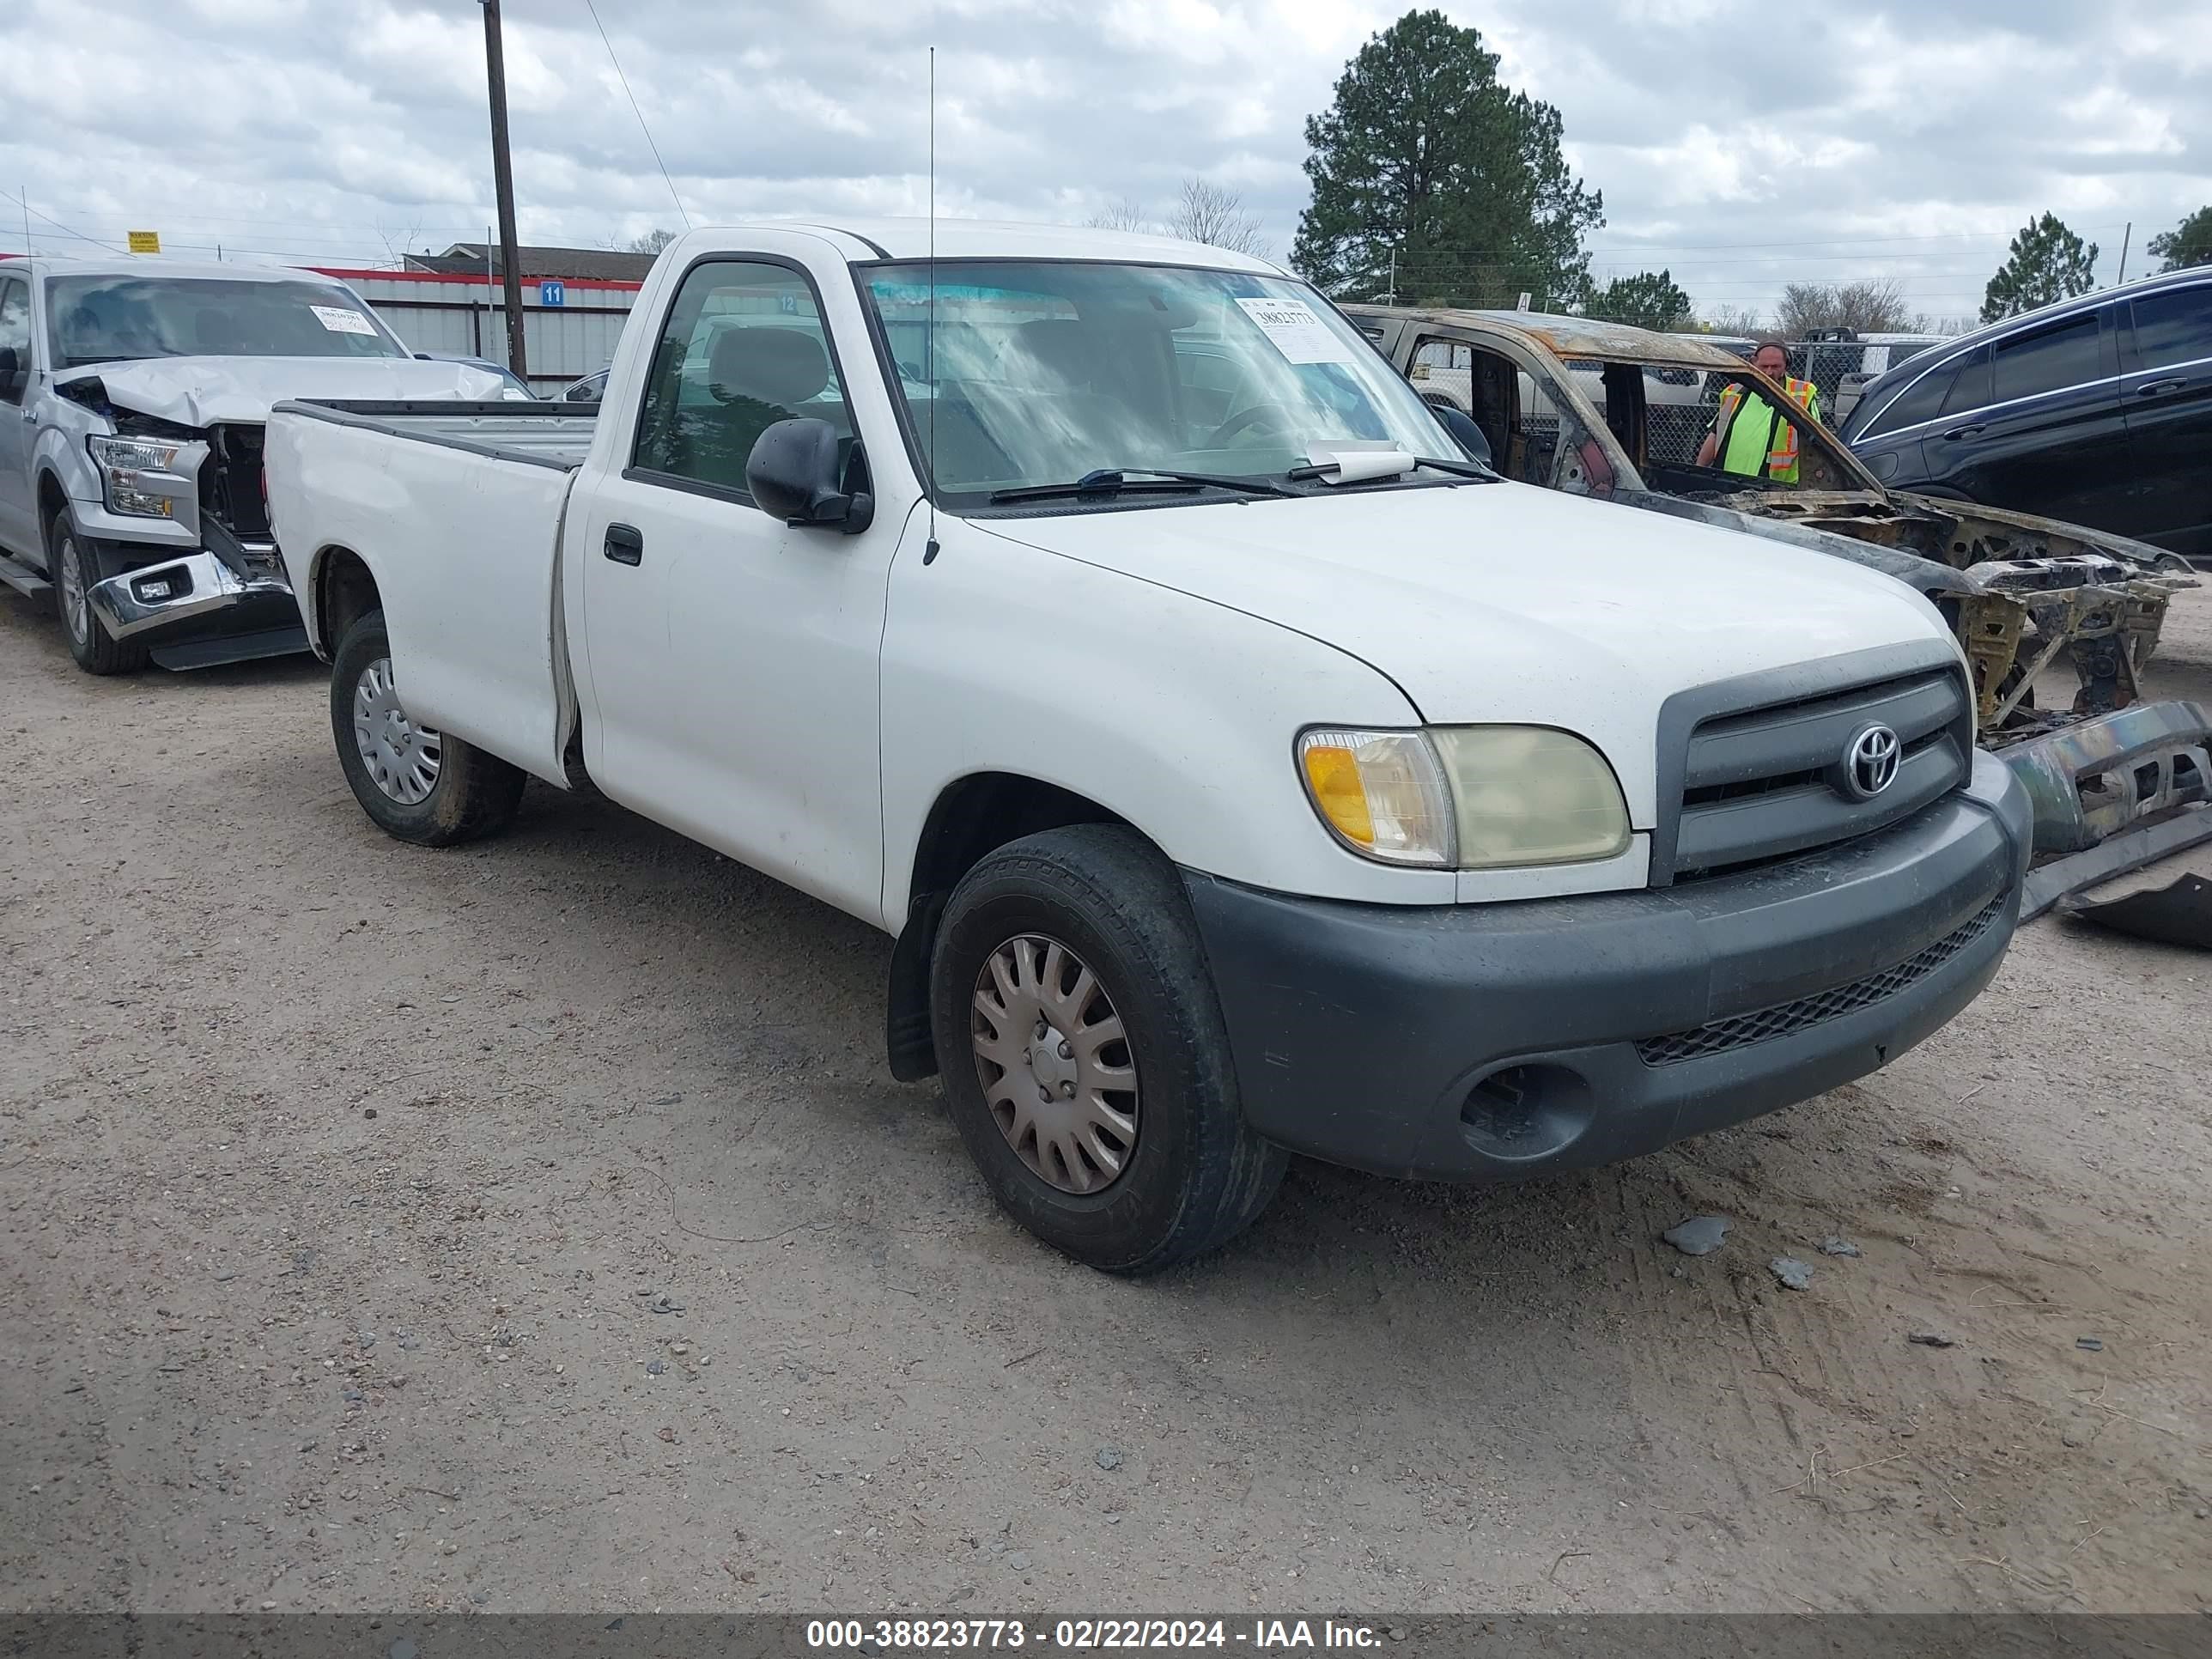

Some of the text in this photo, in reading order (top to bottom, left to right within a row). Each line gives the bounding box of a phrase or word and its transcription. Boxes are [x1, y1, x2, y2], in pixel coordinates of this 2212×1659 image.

[545, 286, 560, 302] 11
[781, 295, 795, 311] 12
[1255, 311, 1316, 325] 38823773
